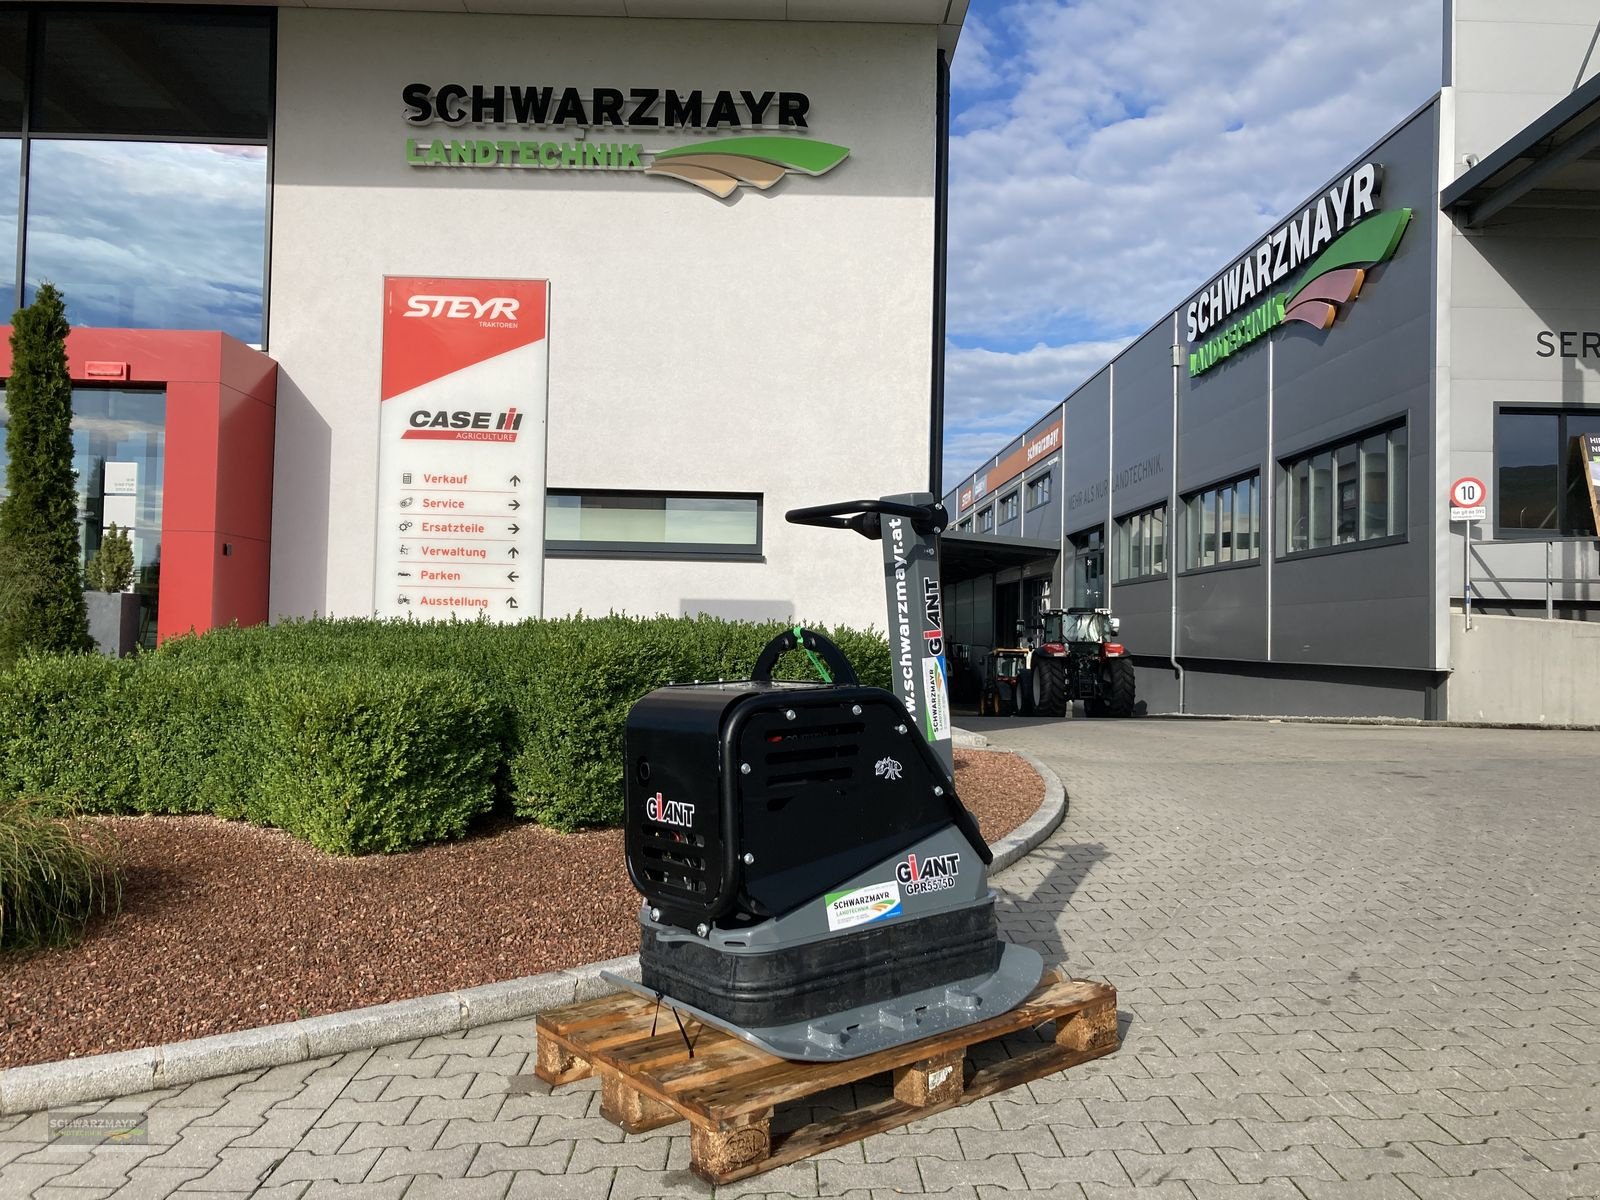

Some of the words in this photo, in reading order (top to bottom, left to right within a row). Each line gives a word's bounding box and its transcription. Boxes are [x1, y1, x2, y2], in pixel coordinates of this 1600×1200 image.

[402, 83, 810, 129] SCHWARZMAYR
[405, 138, 642, 169] LANDTECHNIK
[1187, 162, 1376, 343] SCHWARZMAYR
[402, 295, 520, 320] STEYR
[479, 321, 518, 329] TRAKTOREN
[409, 410, 491, 429] CASE
[455, 432, 513, 441] AGRICULTURE
[423, 474, 468, 484] Verkauf
[1461, 486, 1475, 500] 10
[422, 499, 465, 509] Service
[422, 522, 485, 533] Ersatzteile
[421, 546, 486, 558] Verwaltung
[420, 570, 461, 581] Parken
[420, 596, 488, 608] Ausstellung
[889, 517, 917, 722] w.schwarzmayr.at
[929, 669, 939, 732] SCHWARZMAYR
[905, 876, 955, 897] GPR5575D
[833, 891, 890, 910] SCHWARZMAYR
